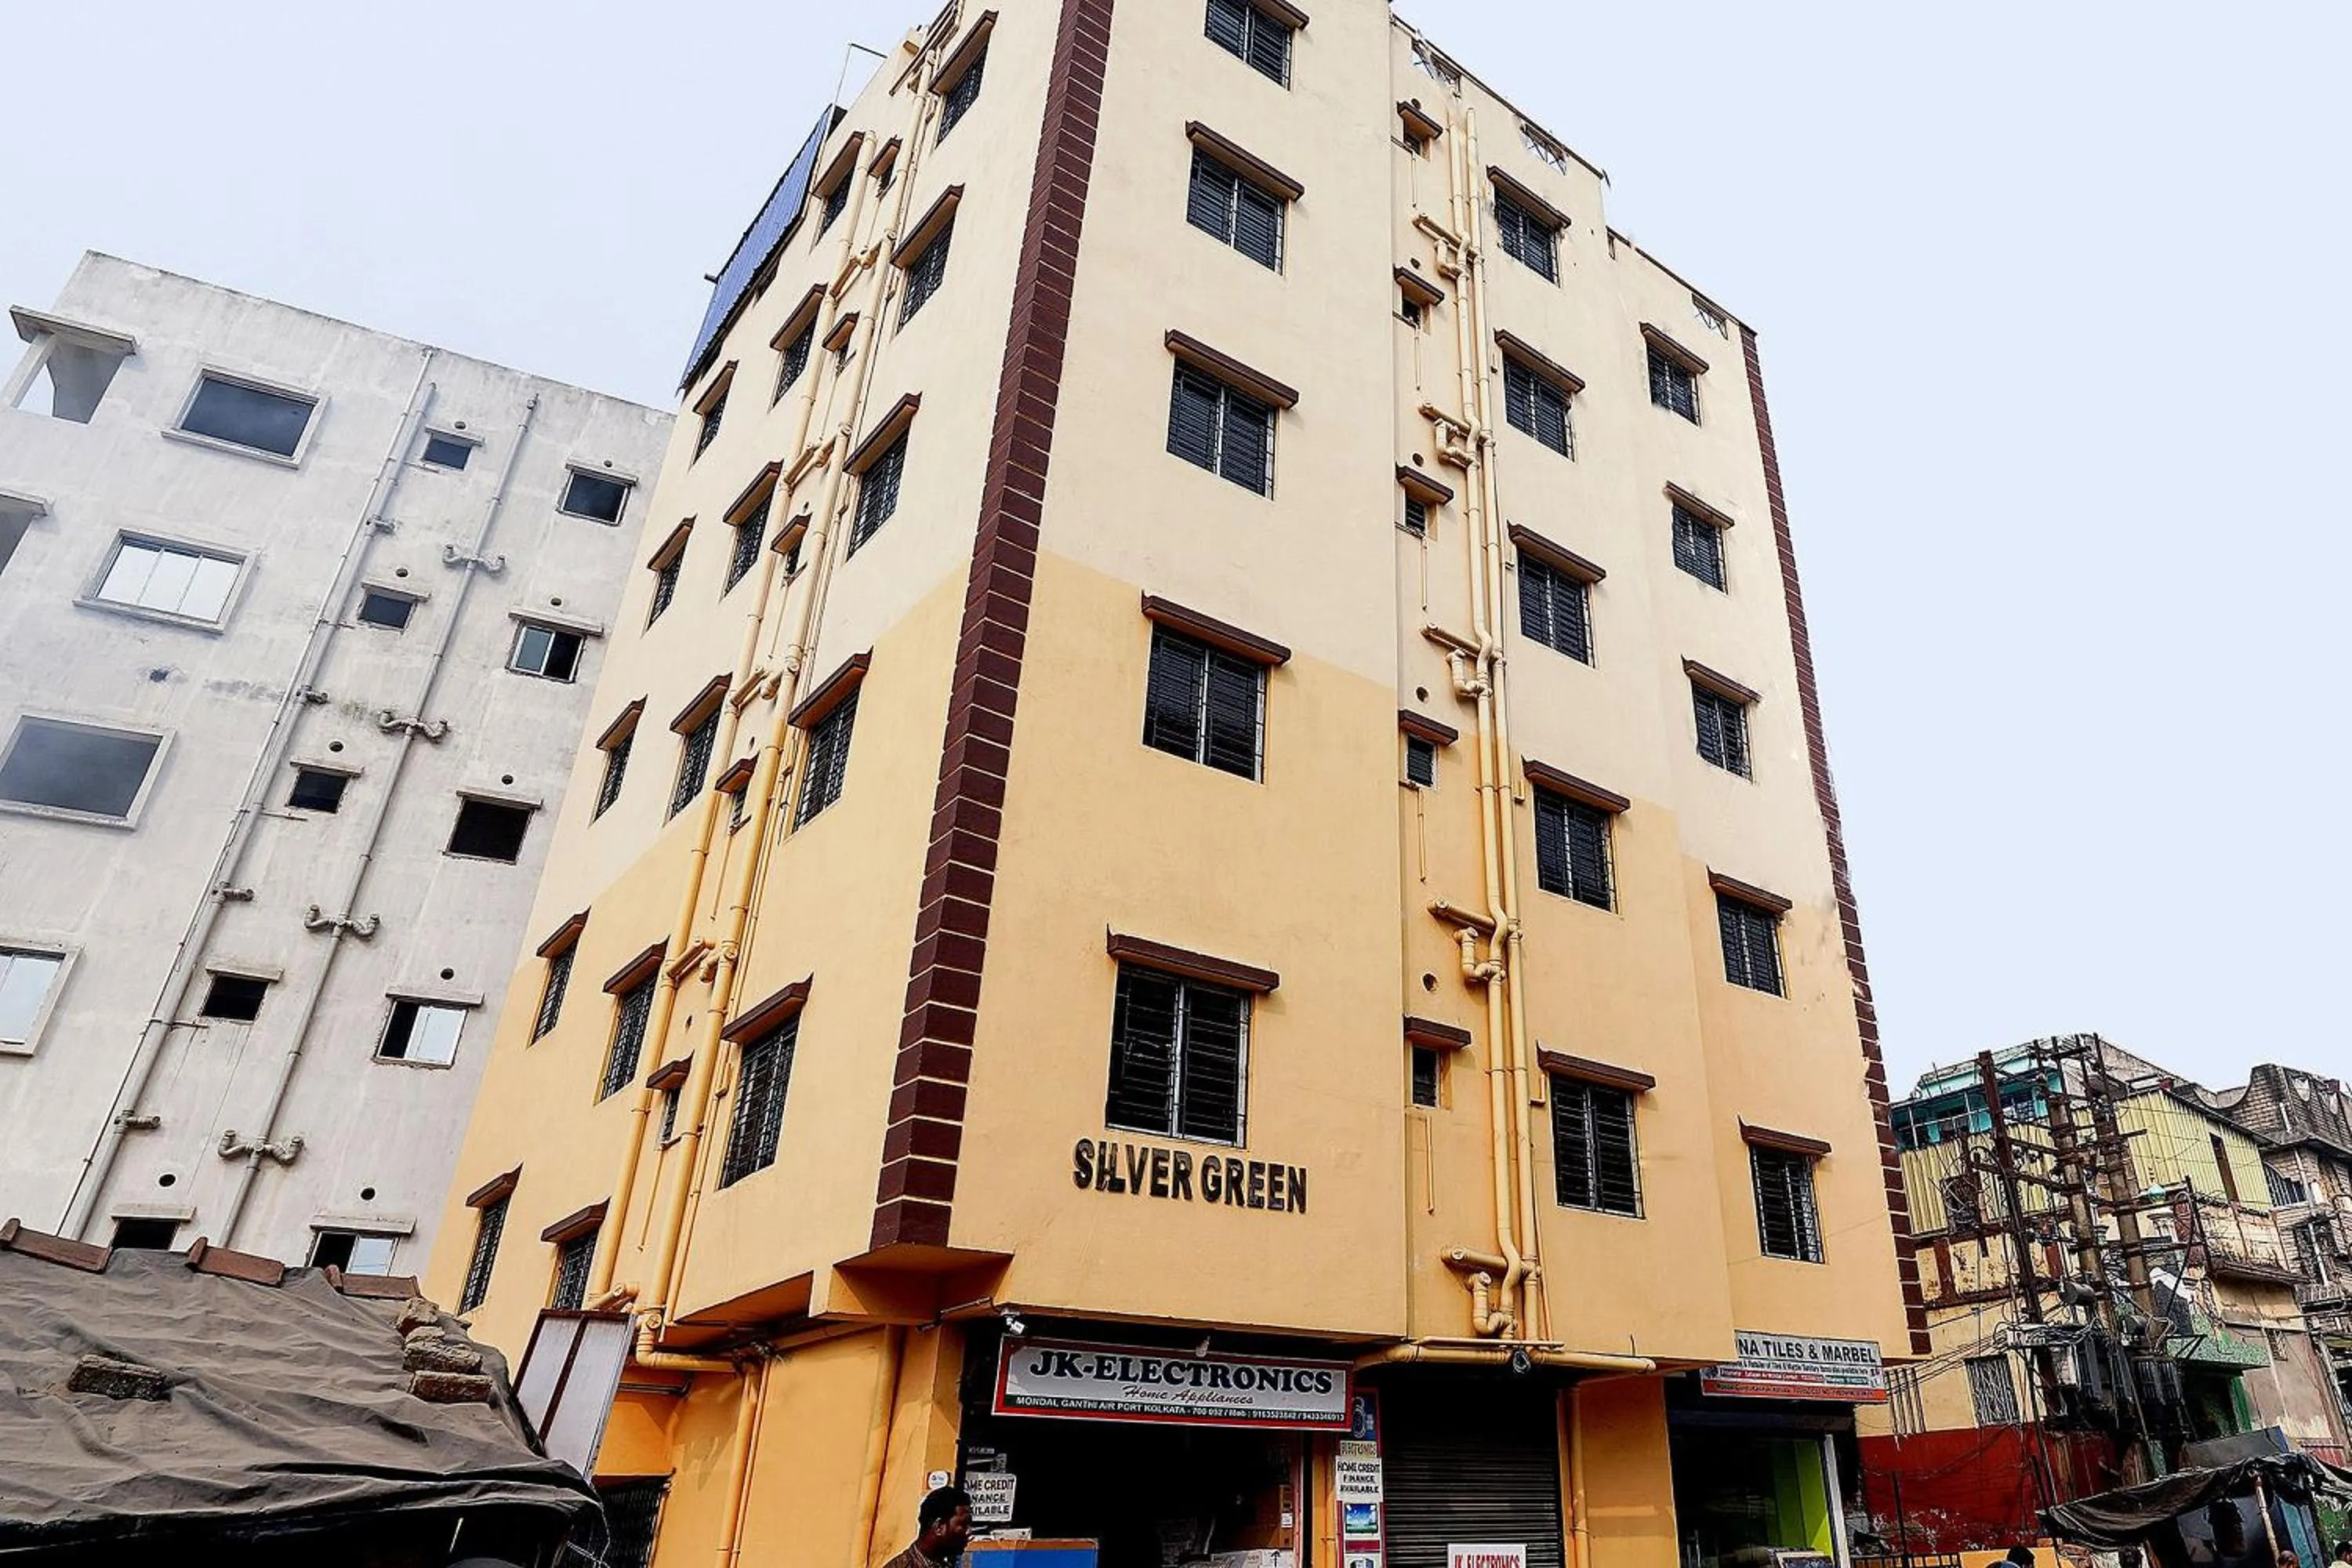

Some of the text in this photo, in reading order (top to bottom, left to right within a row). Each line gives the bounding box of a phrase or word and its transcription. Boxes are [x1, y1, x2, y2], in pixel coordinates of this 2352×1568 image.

[1073, 1139, 1307, 1214] SILVER GREEN
[1736, 1339, 1876, 1363] NA TILES & MARBEL
[1029, 1350, 1333, 1395] JK-ELECTRONICS
[1122, 1385, 1254, 1404] Home Appliances
[1015, 1396, 1058, 1408] MONDAL
[1117, 1402, 1142, 1412] PORT
[1144, 1404, 1185, 1414] KOLKATA
[964, 1479, 1014, 1490] OME CREDIT
[971, 1493, 1006, 1503] NANCE
